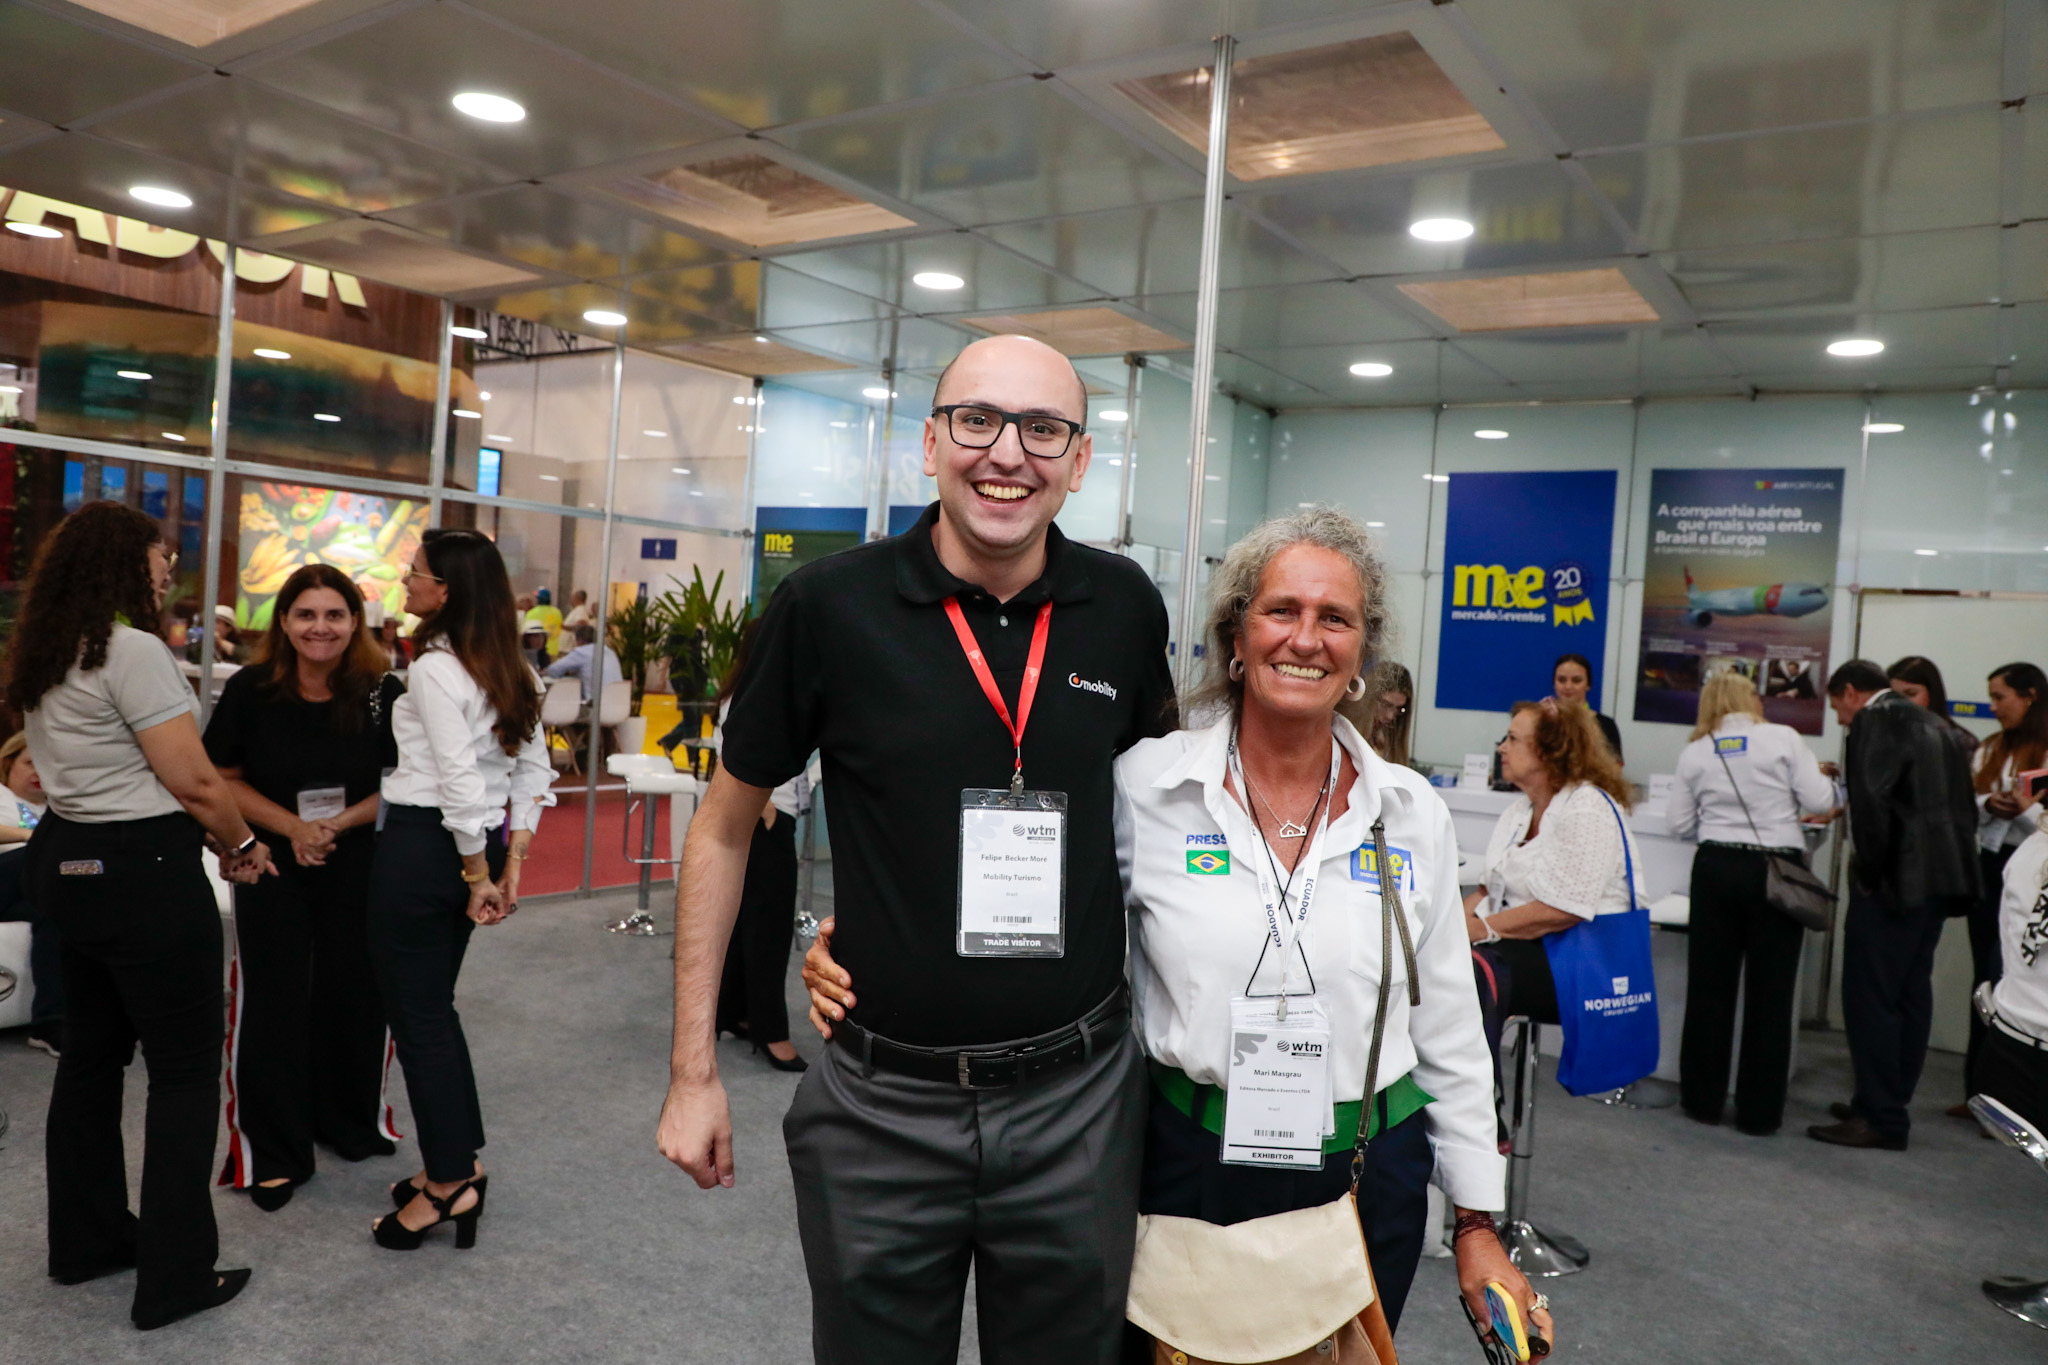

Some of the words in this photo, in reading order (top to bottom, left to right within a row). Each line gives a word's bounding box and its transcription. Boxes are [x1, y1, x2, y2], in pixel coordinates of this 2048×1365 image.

[1657, 504, 1669, 517] A
[1672, 505, 1755, 520] companhia
[1757, 504, 1802, 518] aérea
[1677, 520, 1706, 532] que
[1708, 519, 1744, 531] mais
[1746, 522, 1775, 532] voa
[1777, 520, 1822, 533] entre
[1655, 530, 1698, 544] Brasil
[1698, 535, 1709, 545] e
[1711, 531, 1767, 548] Europa
[1552, 567, 1581, 590] 20
[1557, 588, 1583, 599] ANOS
[1080, 680, 1117, 700] mobility
[1028, 825, 1056, 836] wtm
[1186, 834, 1227, 845] PRESS
[981, 854, 1002, 862] Felipe
[1005, 854, 1028, 862] Becker
[983, 873, 1012, 881] Mobility
[1298, 878, 1314, 920] ECUADOR
[1011, 939, 1042, 947] VISITOR
[1584, 991, 1652, 1012] NORWEGIAN
[1292, 1041, 1322, 1052] wtm
[1271, 1070, 1302, 1078] Masgrau
[1252, 1152, 1294, 1160] EXHIBITOR
